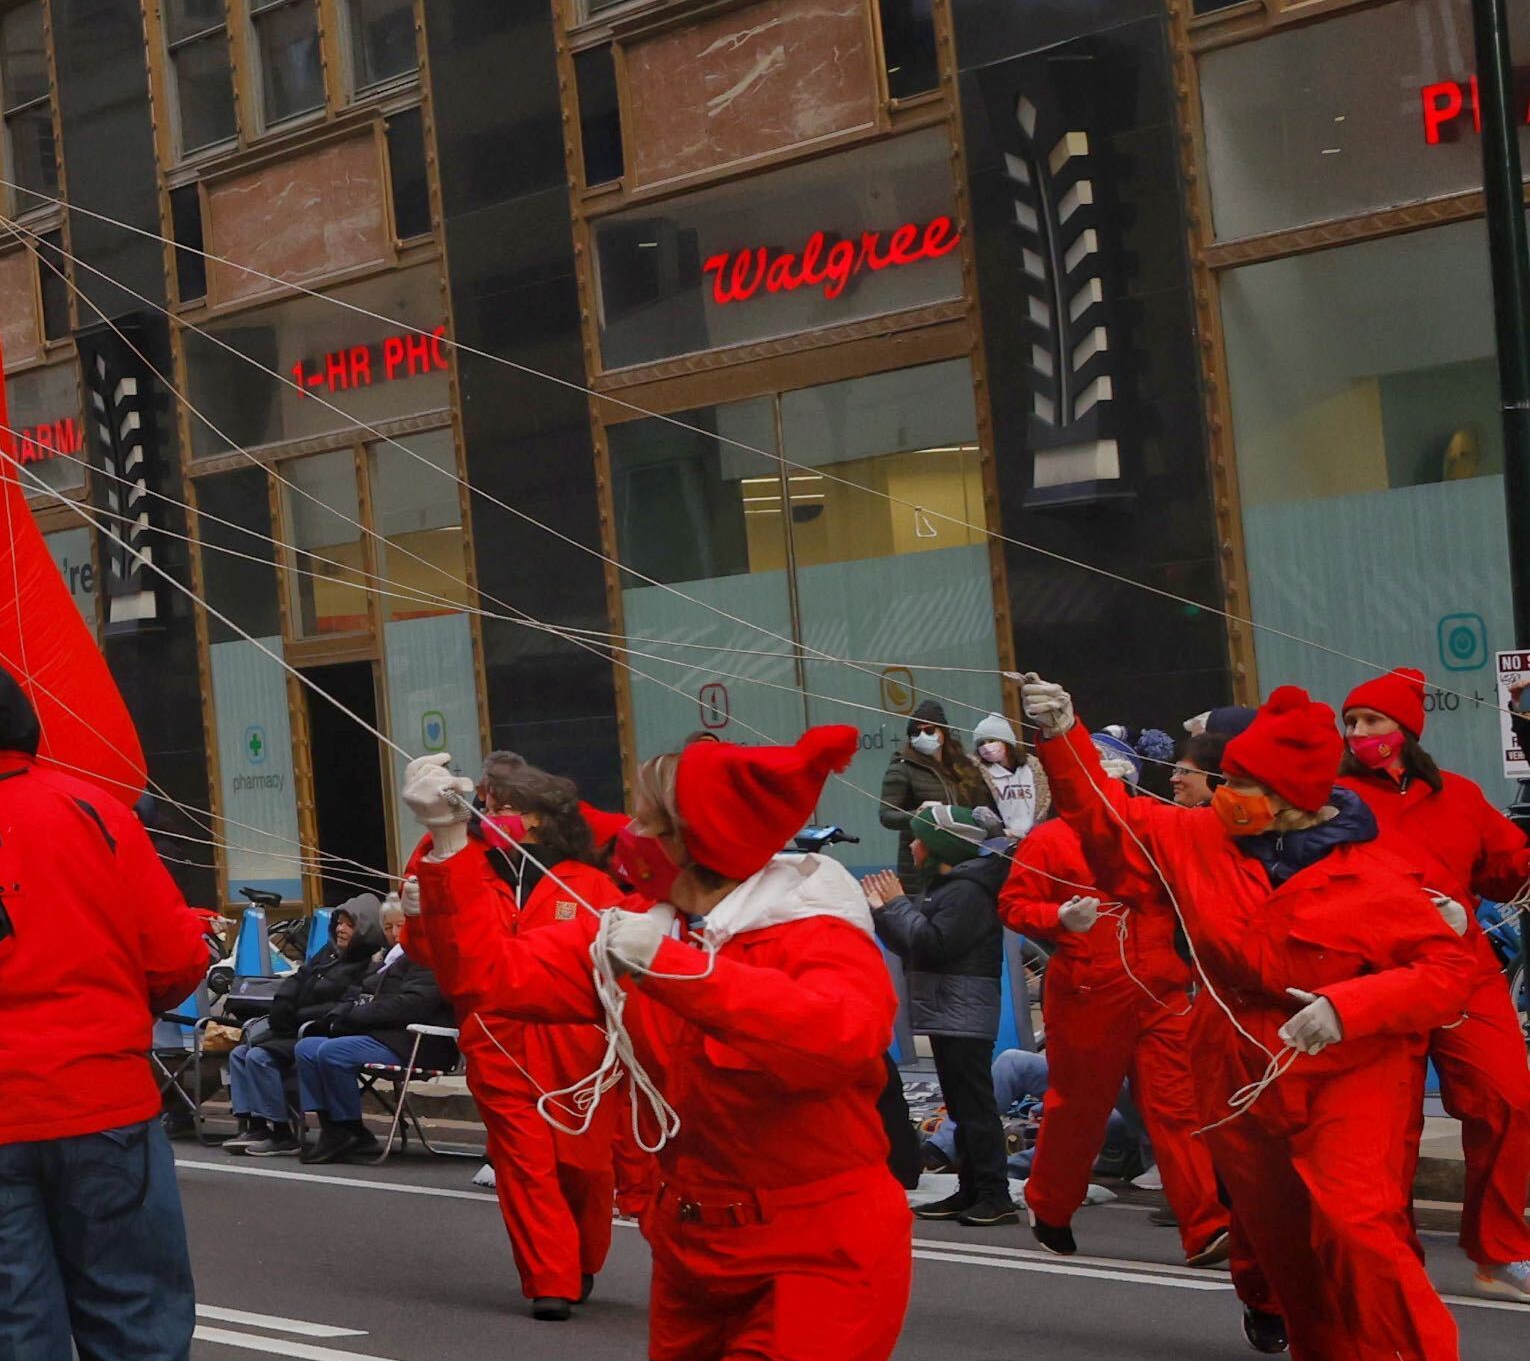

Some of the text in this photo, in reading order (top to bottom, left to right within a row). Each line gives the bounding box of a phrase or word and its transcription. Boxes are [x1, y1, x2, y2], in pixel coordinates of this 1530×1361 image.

[292, 345, 373, 399] 1-HR
[1501, 655, 1522, 671] NO
[1423, 689, 1459, 712] oto
[233, 774, 284, 794] pharmacy
